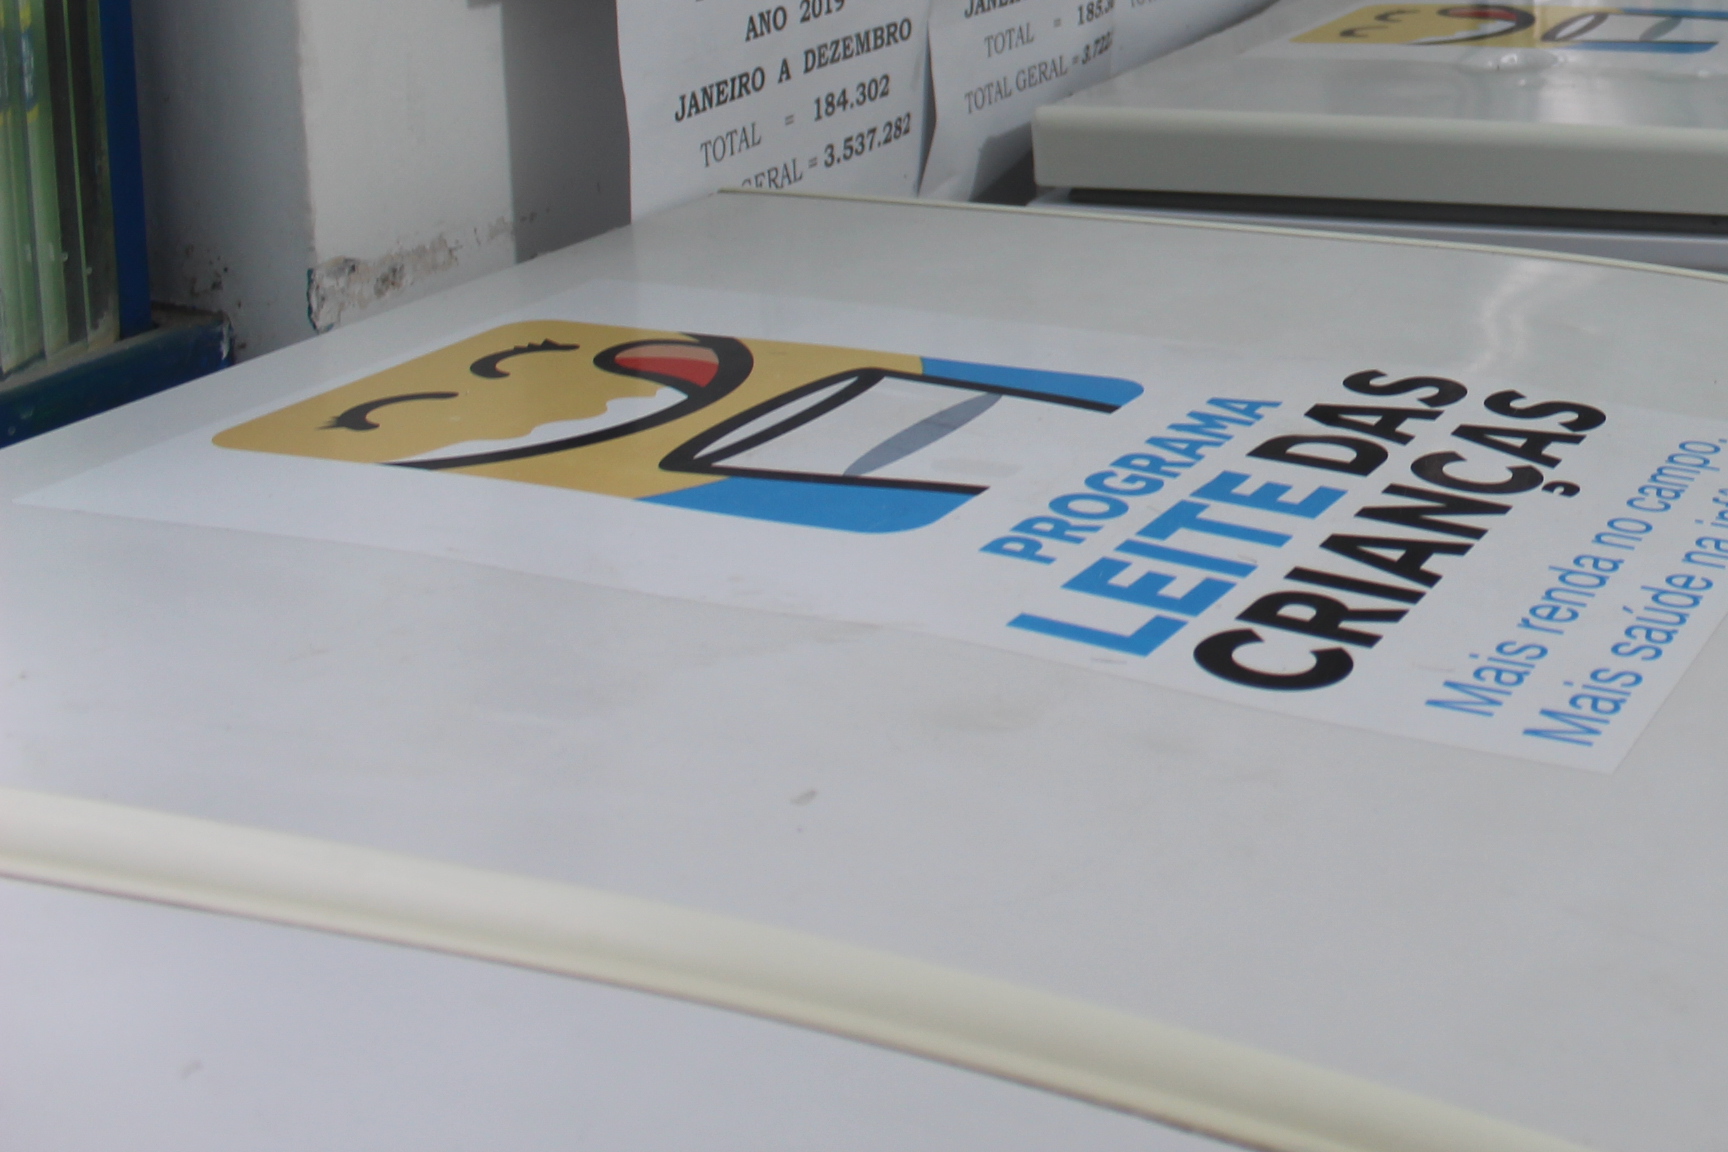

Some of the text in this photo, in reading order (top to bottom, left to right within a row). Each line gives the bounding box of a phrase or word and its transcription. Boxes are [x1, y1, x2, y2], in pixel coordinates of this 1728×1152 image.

[675, 17, 912, 122] JANEIRO A DEZEMBRO
[745, 5, 787, 42] ANO
[983, 22, 1034, 59] TOTAL
[700, 121, 762, 168] TOTAL
[814, 73, 890, 122] 184.302
[964, 55, 1068, 115] TOTAL GERAL
[824, 112, 912, 168] 3.537.282
[978, 396, 1284, 566] PROGRAMA
[1006, 369, 1469, 658] LEITE DAS
[1193, 389, 1607, 691] CRIANÇAS
[1424, 438, 1728, 718] Mais renda no campo.
[1522, 667, 1644, 748] Mais
[1610, 572, 1714, 662] saúde
